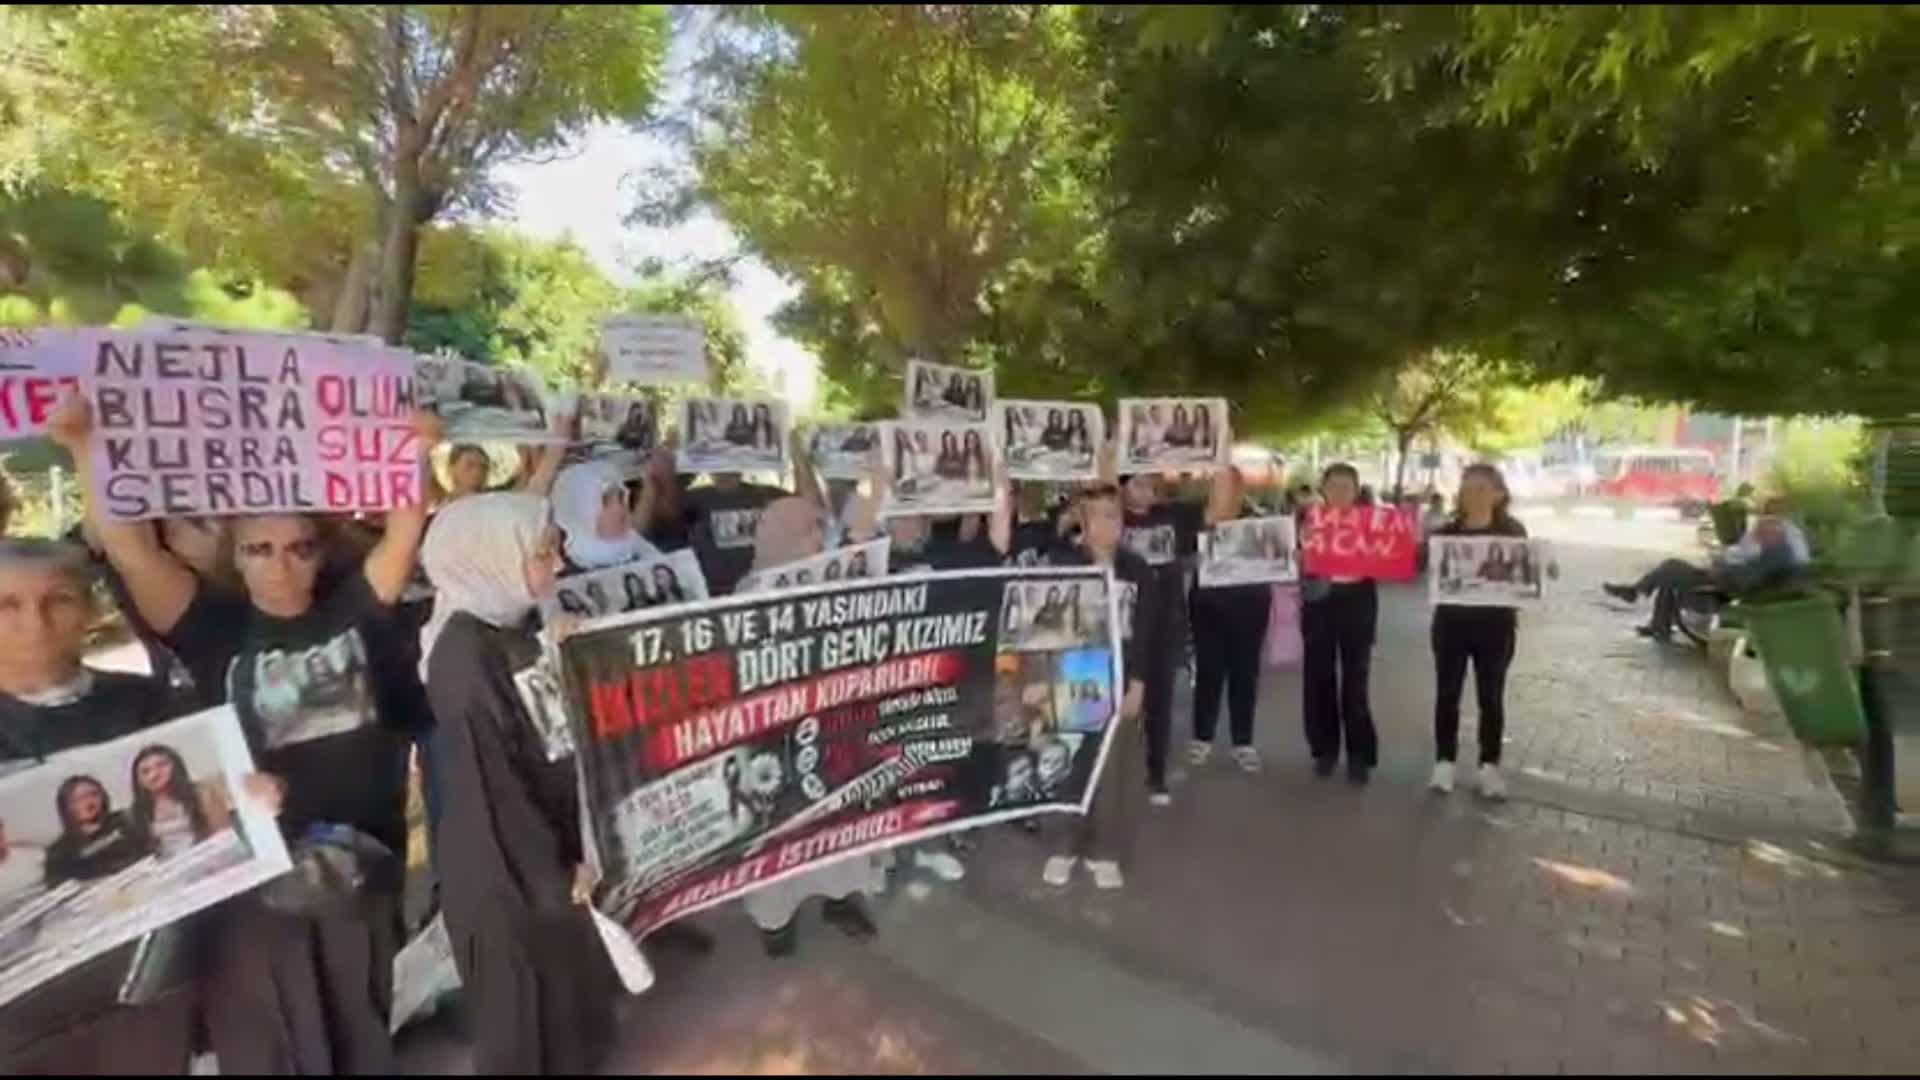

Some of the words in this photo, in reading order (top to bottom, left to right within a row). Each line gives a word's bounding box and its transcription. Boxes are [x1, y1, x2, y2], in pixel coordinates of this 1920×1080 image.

[95, 340, 302, 384] NEJLA
[97, 386, 306, 432] BUSRA
[105, 434, 299, 471] KUBRA
[317, 423, 417, 464] SUZ
[106, 471, 314, 517] SERDIL
[325, 470, 413, 509] DUR
[681, 618, 713, 654] 16
[722, 610, 757, 645] VE
[767, 604, 795, 633] 14
[738, 637, 815, 691] DÖRT
[821, 622, 890, 670] GENÇ
[894, 610, 989, 653] KIZIMIZ
[674, 684, 807, 759] HAYATTAN
